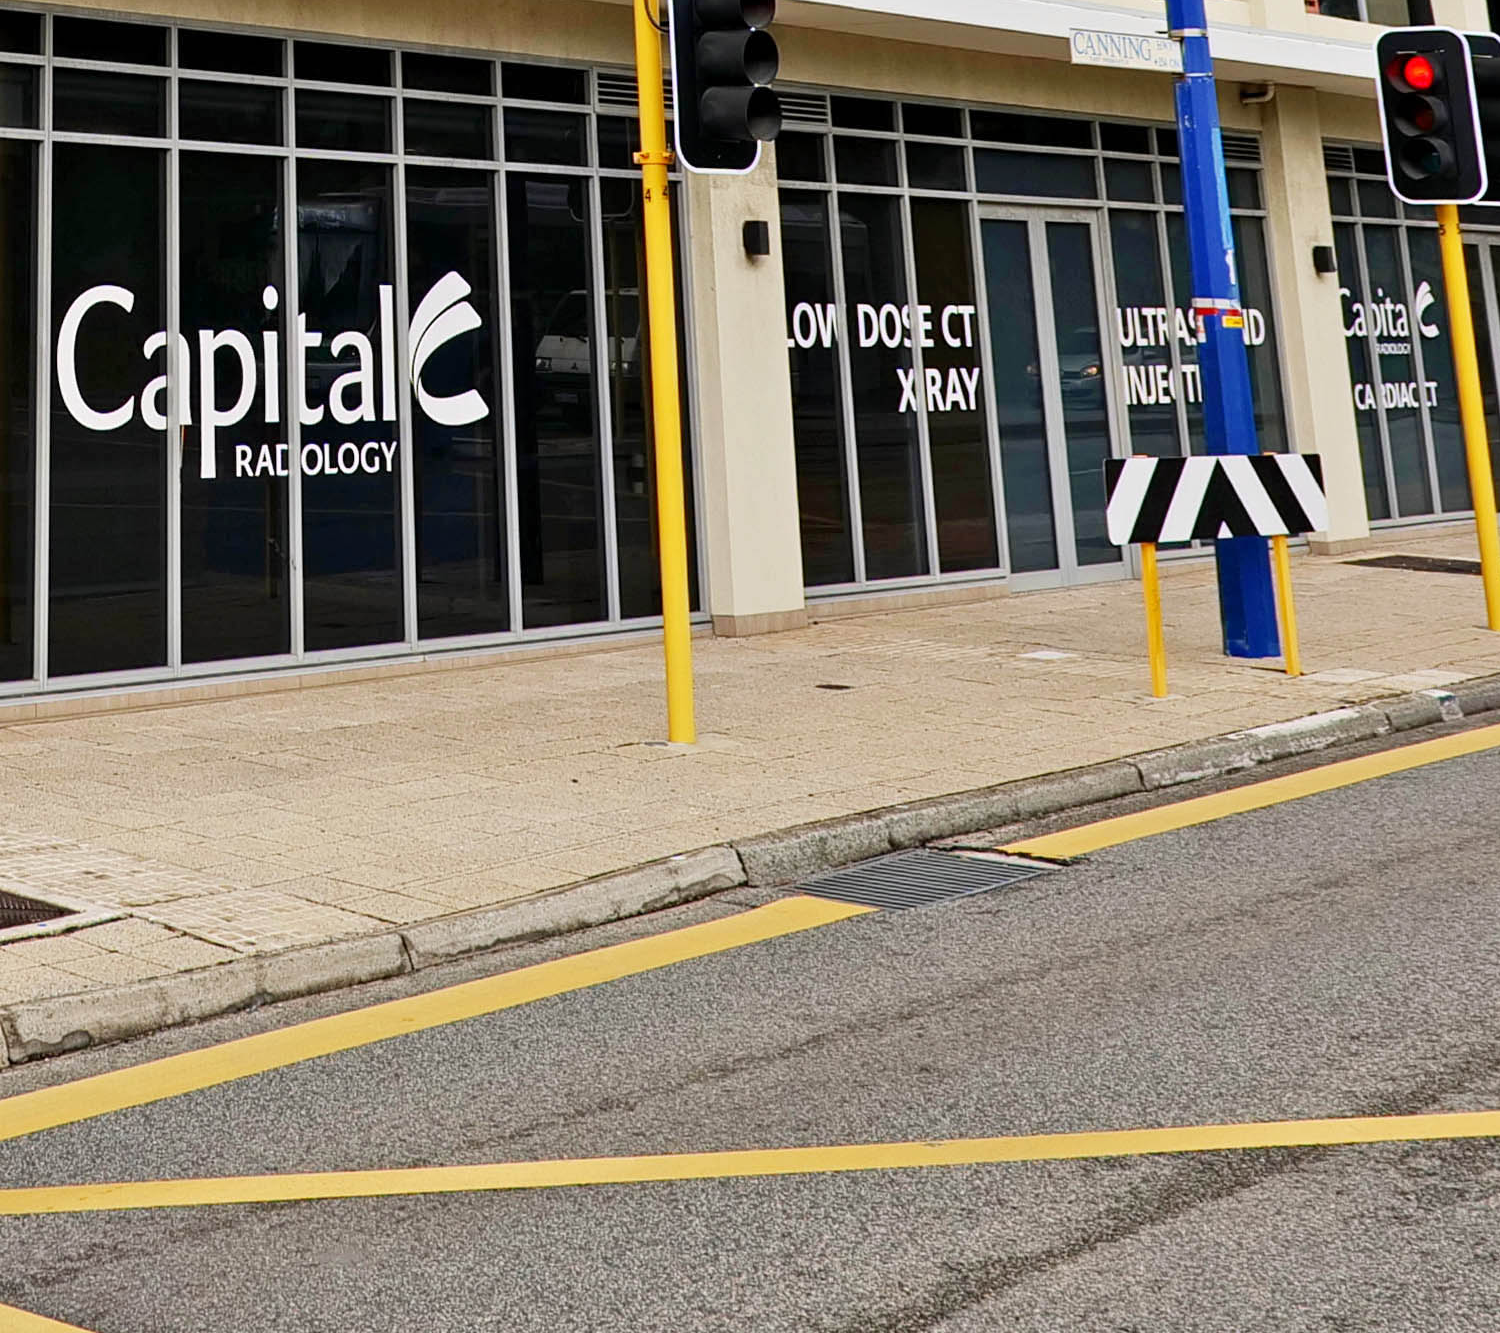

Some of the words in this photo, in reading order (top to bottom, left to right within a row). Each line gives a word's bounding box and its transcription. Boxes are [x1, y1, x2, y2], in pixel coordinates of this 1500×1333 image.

[1073, 32, 1152, 61] CANNING
[787, 302, 840, 349] OW
[857, 303, 935, 348] DOSE
[942, 305, 975, 348] CT
[1116, 307, 1265, 347] ULTRASD
[1339, 287, 1411, 337] Caita
[56, 284, 397, 479] Capital
[1354, 381, 1420, 410] CADIAC
[235, 441, 398, 478] RADOLOGY
